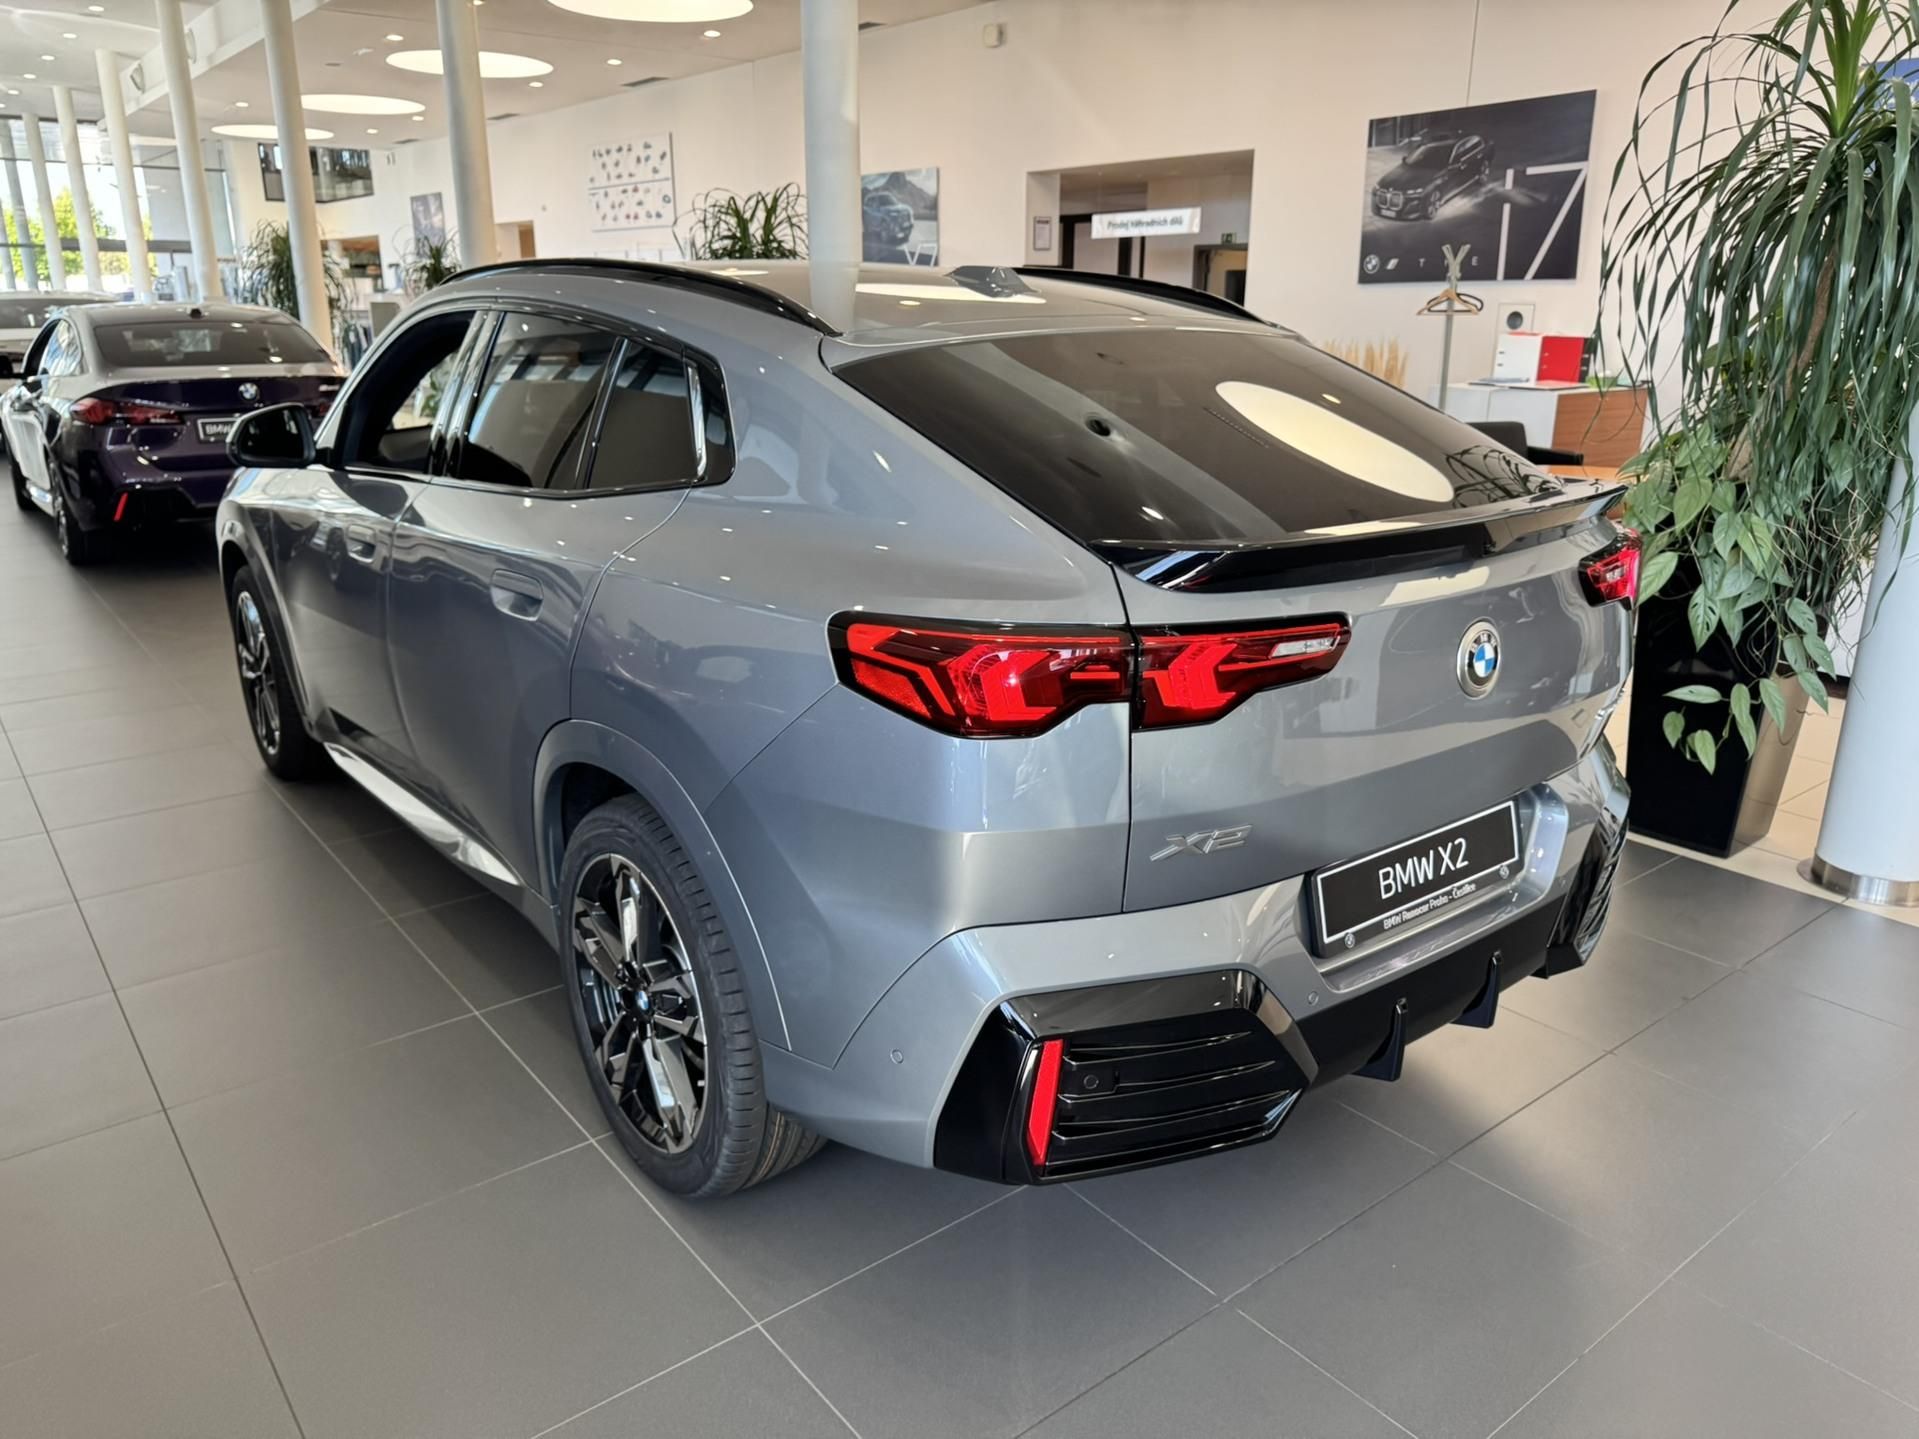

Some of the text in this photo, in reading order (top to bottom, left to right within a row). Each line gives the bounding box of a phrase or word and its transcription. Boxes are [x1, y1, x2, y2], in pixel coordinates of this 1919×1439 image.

[1149, 823, 1252, 862] X2
[1378, 838, 1469, 900] BMW X2
[1383, 913, 1402, 930] BMW
